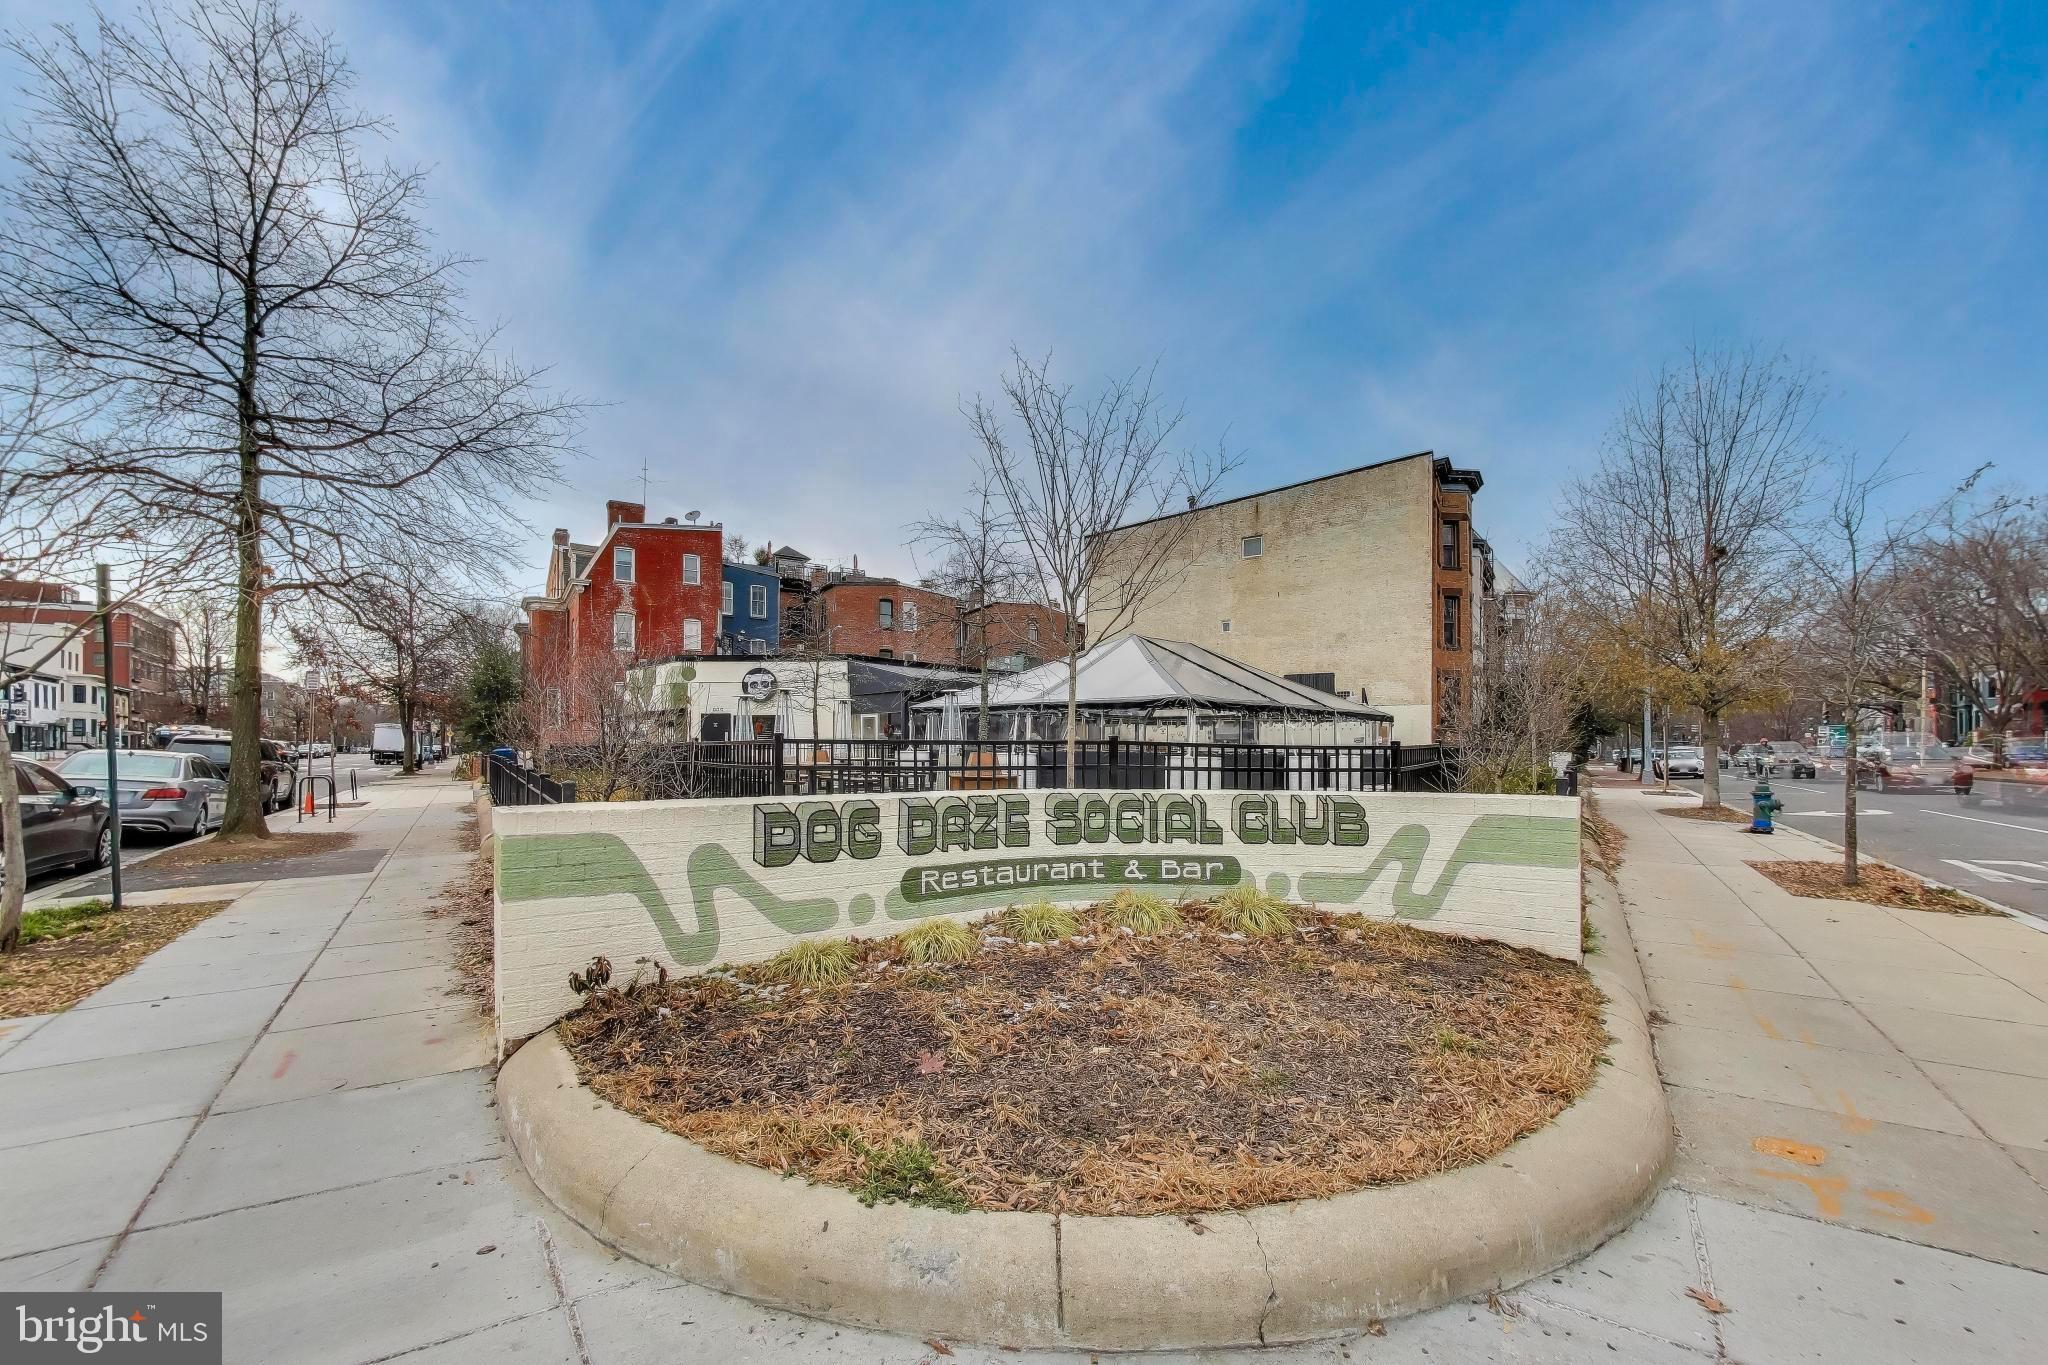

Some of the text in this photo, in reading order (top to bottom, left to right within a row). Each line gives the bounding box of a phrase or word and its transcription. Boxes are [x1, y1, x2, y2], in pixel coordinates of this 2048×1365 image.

[753, 792, 1370, 867] DOG DAZE SOCIAL CLUB
[920, 858, 1225, 896] Restaurant & Bar
